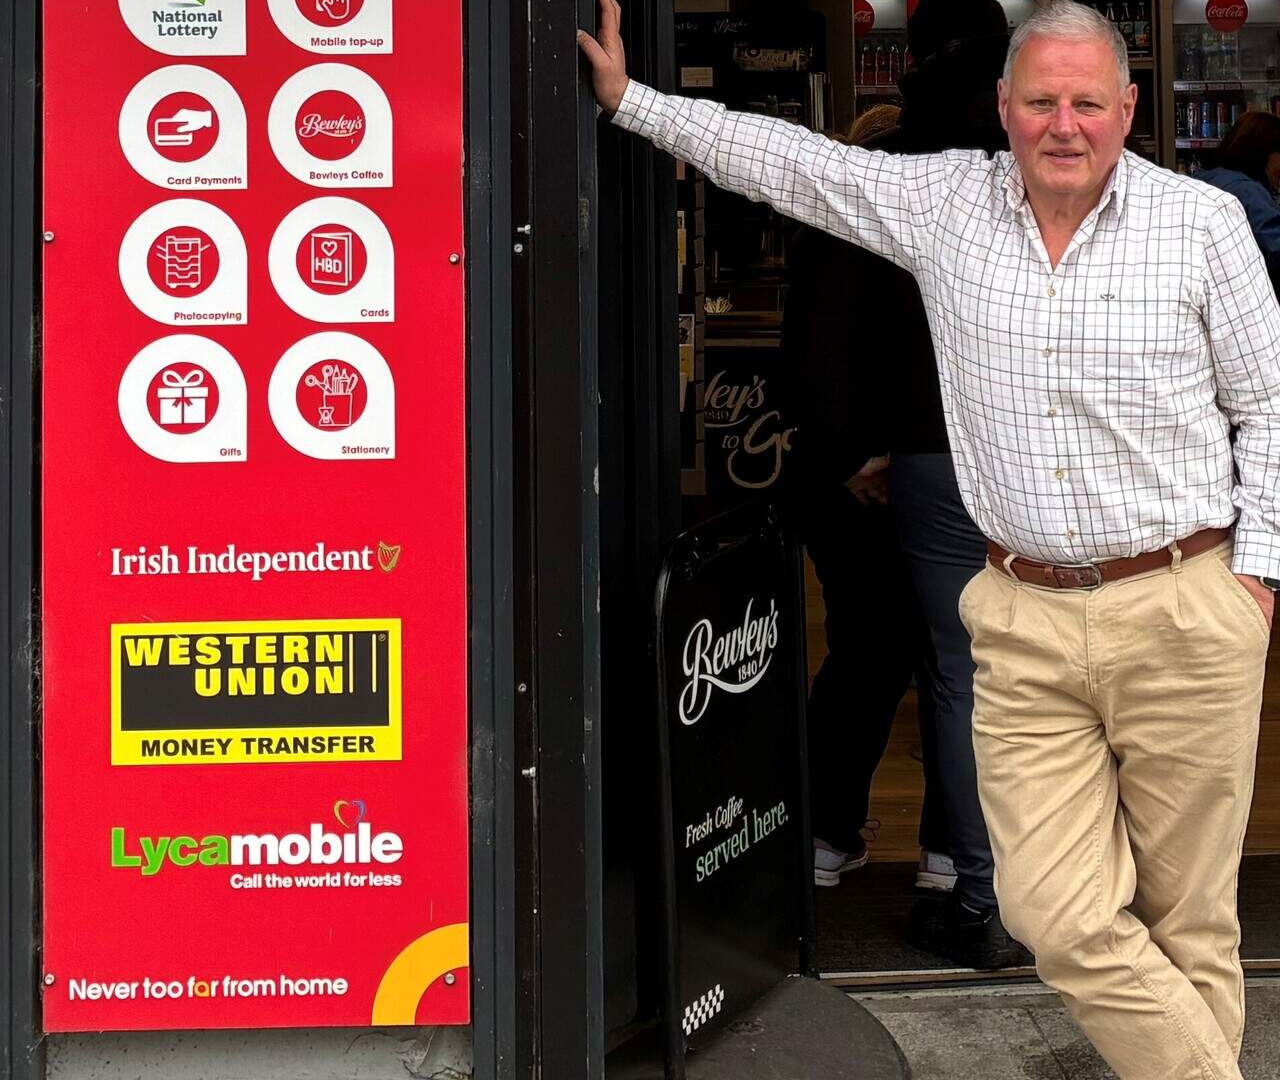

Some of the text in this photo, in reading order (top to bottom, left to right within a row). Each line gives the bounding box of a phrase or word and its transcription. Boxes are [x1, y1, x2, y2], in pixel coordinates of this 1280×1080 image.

[152, 10, 223, 23] National
[158, 23, 218, 39] Lottery
[310, 37, 384, 48] Mobile top-up
[298, 113, 363, 138] Bewley's
[167, 175, 242, 187] Card Payments
[309, 170, 384, 181] Bewleys Coffee
[314, 257, 342, 275] HBD
[173, 310, 242, 322] Photocopying
[360, 308, 390, 318] Cards
[704, 370, 767, 422] ley's
[219, 447, 242, 457] Gifts
[341, 445, 390, 455] Stationery
[110, 542, 373, 581] Irish Independent
[124, 633, 343, 667] WESTERN
[678, 597, 779, 726] Bewley's
[194, 666, 343, 697] UNION
[737, 663, 757, 683] 1840
[140, 735, 375, 757] MONEY TRANSFER
[685, 795, 744, 848] Fresh Coffee
[111, 822, 403, 876] Lycamobile
[695, 799, 790, 884] served here.
[230, 871, 402, 889] Call the world for less
[68, 974, 349, 1001] Never too far from home
